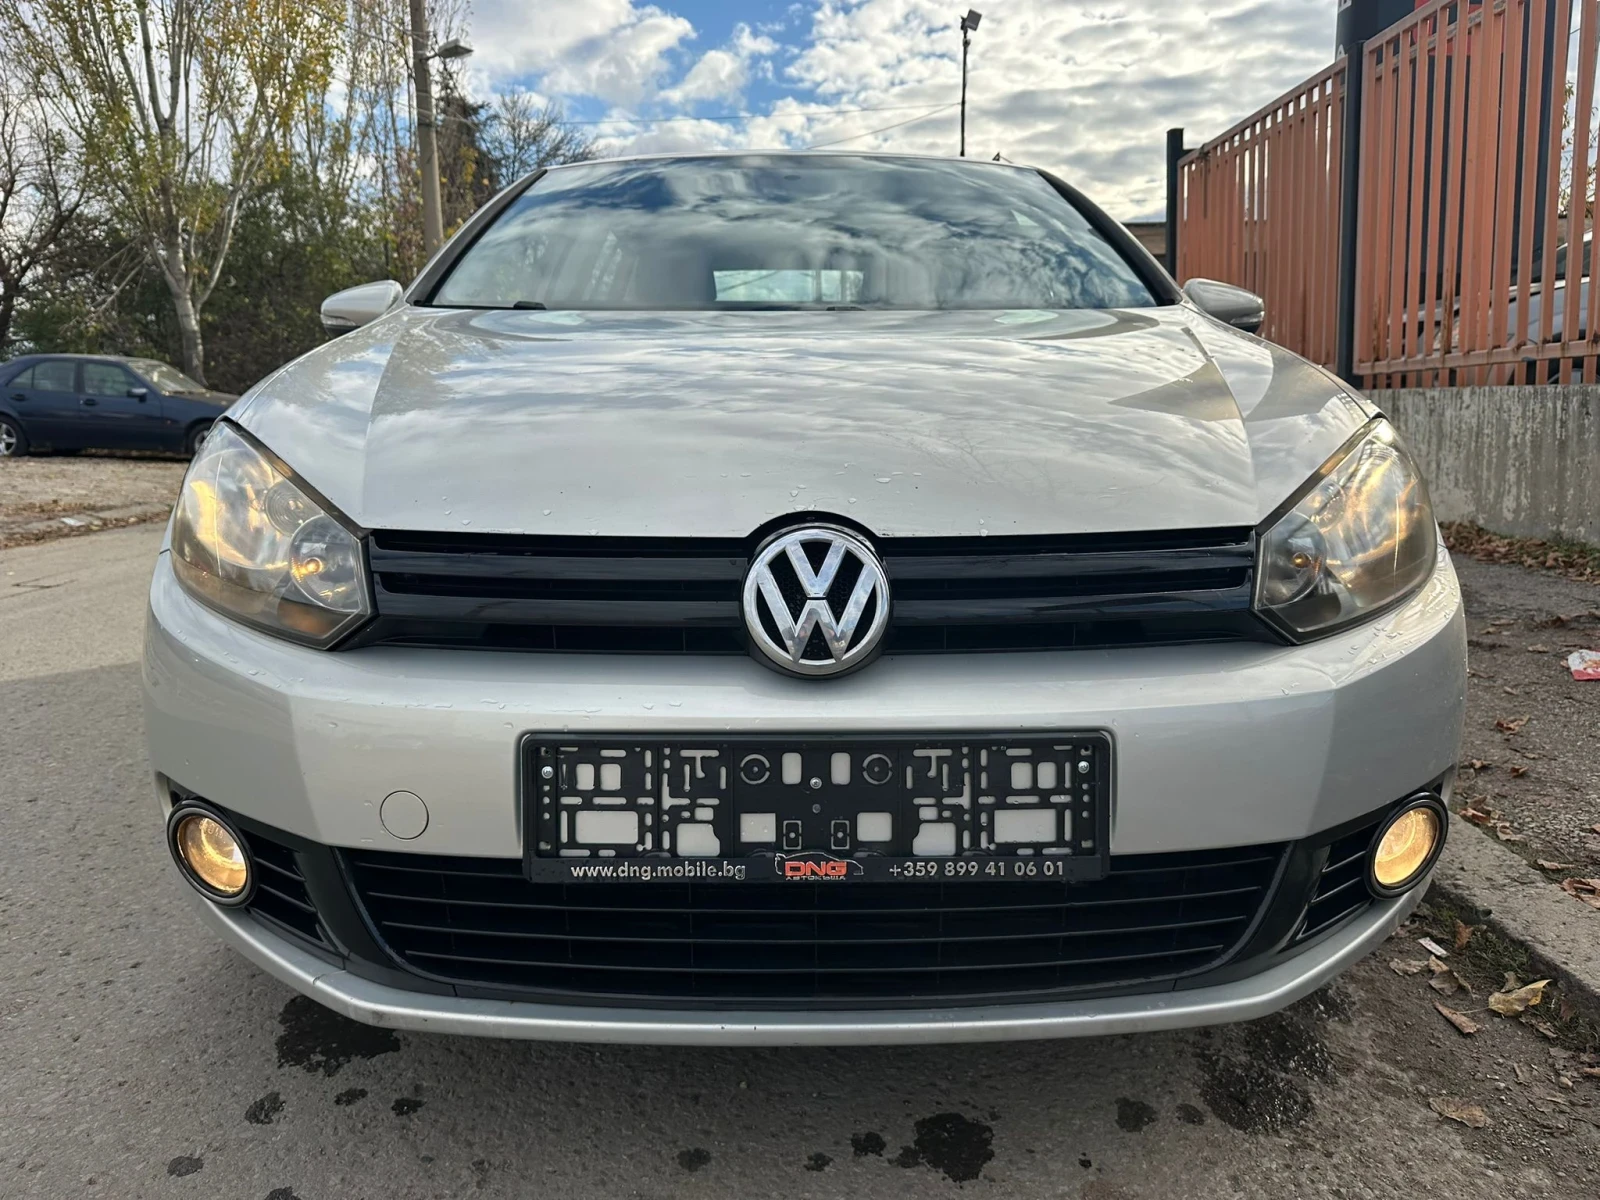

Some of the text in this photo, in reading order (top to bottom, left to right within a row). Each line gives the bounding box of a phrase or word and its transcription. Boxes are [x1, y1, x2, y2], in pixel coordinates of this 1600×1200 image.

[752, 535, 883, 667] VW
[570, 861, 747, 882] www.dng.mobile.bg
[785, 861, 847, 876] DNG
[889, 861, 1064, 877] +359 899 41 06 01
